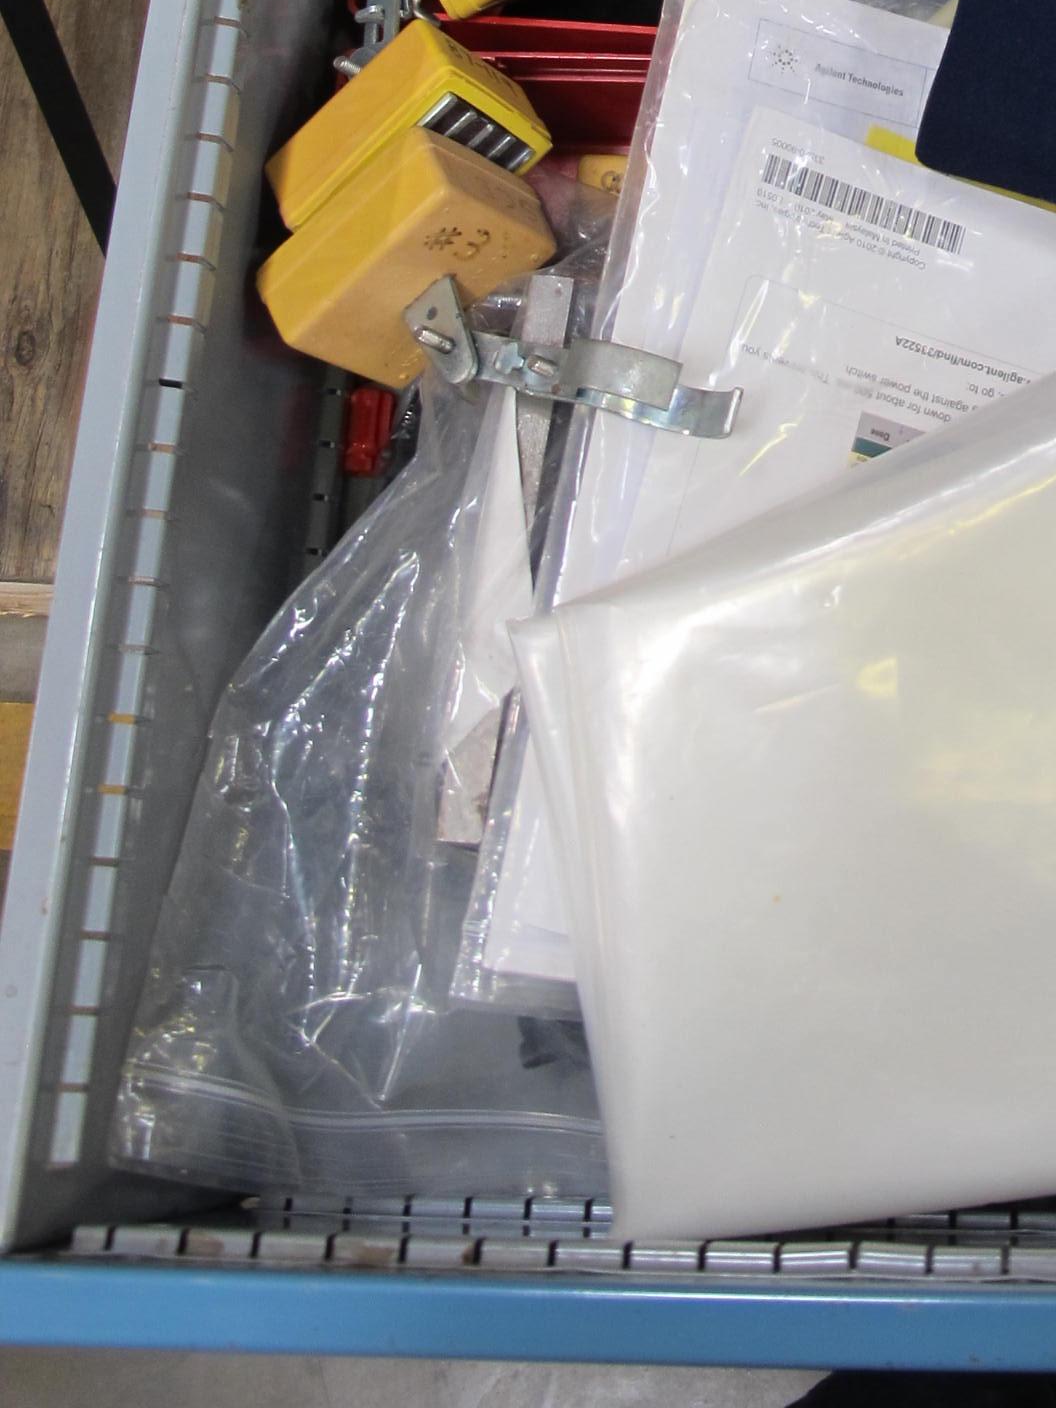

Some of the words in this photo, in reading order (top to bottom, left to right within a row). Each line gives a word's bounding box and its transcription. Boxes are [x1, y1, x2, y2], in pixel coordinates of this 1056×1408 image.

[847, 72, 904, 97] Technologies
[880, 375, 912, 395] power
[876, 391, 906, 408] about
[913, 388, 930, 401] the
[907, 401, 921, 414] for
[923, 407, 951, 423] down
